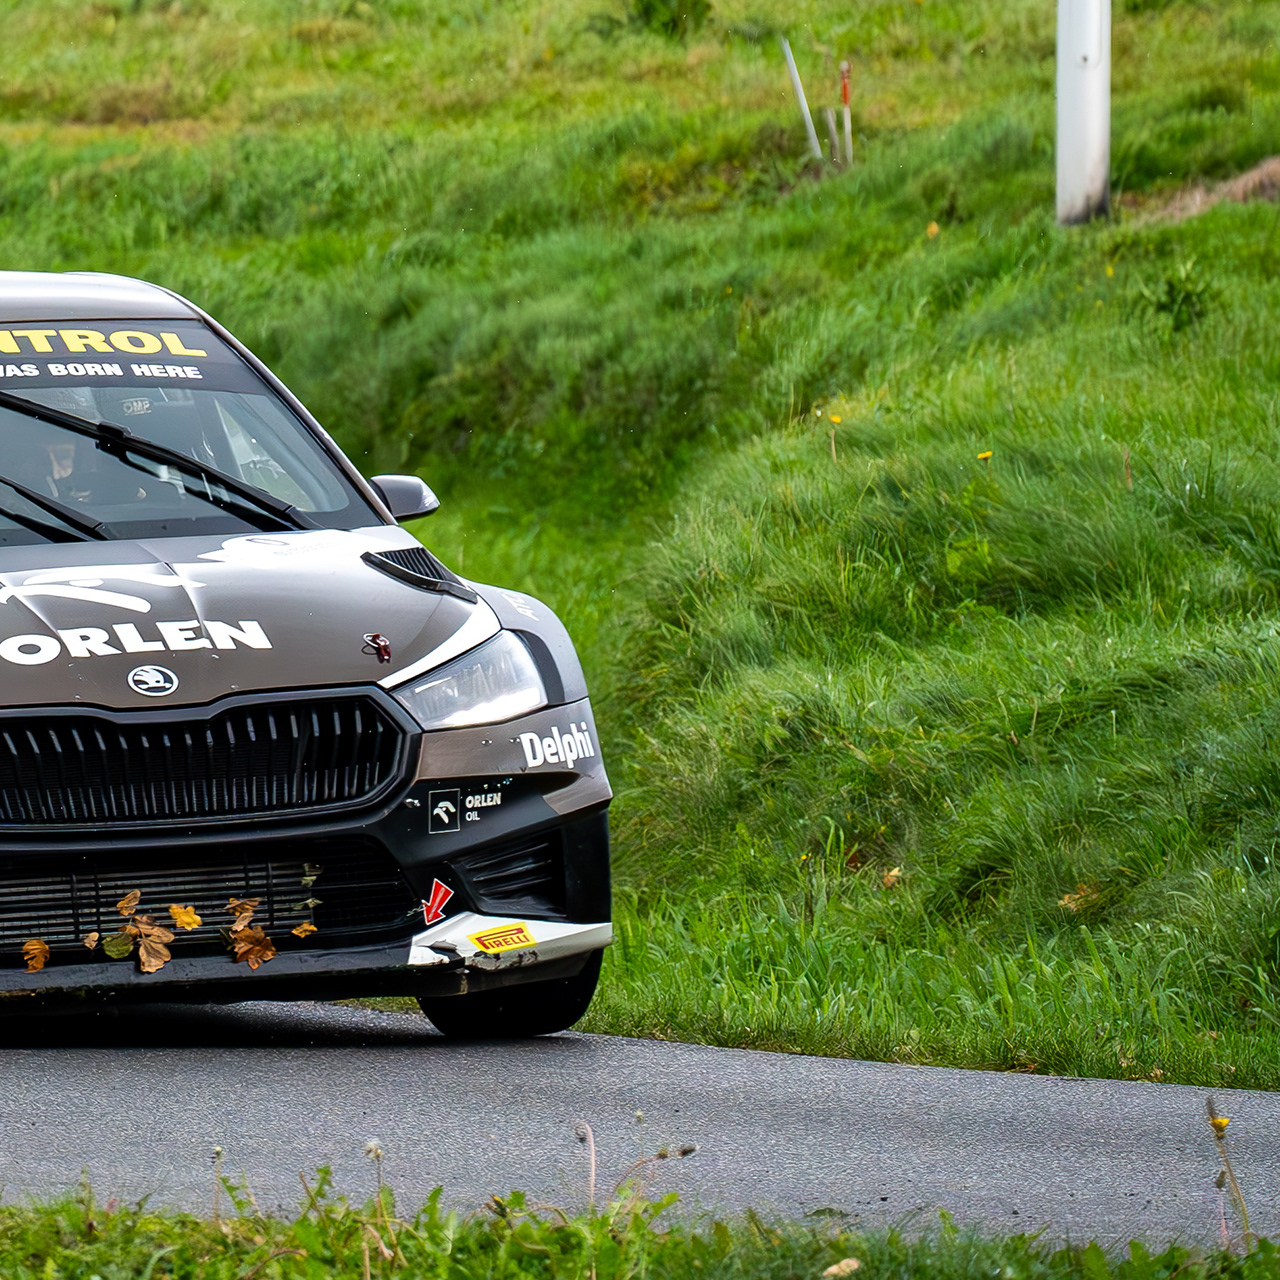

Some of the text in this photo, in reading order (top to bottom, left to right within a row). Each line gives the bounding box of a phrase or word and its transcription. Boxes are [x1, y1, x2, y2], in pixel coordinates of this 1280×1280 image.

[46, 363, 124, 377] BORN
[130, 363, 203, 380] HERE
[519, 721, 595, 769] Delphi
[465, 792, 502, 809] ORLEN
[465, 811, 480, 822] OIL
[475, 926, 530, 950] PIRELLI
